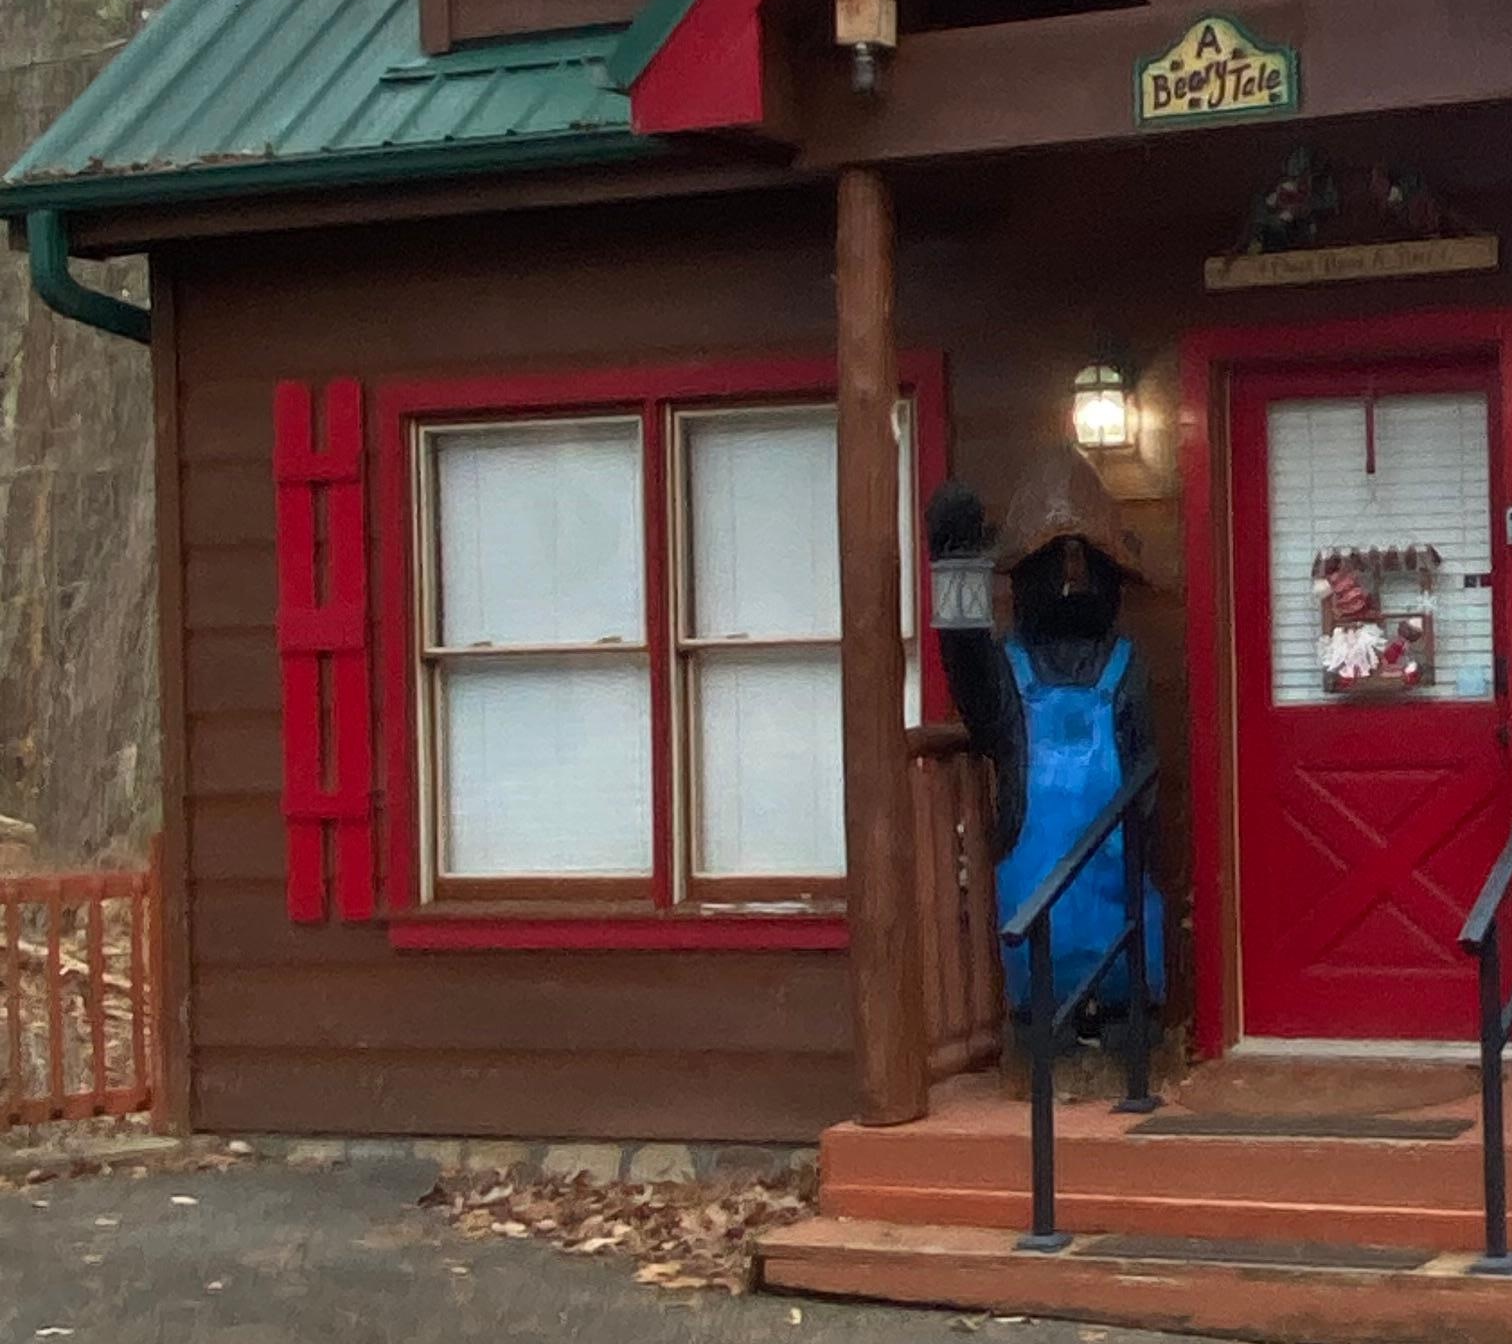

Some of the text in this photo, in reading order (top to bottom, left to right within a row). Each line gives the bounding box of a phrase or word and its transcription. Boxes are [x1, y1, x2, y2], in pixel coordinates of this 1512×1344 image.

[1196, 25, 1221, 58] A
[1153, 60, 1281, 110] Beary Tale
